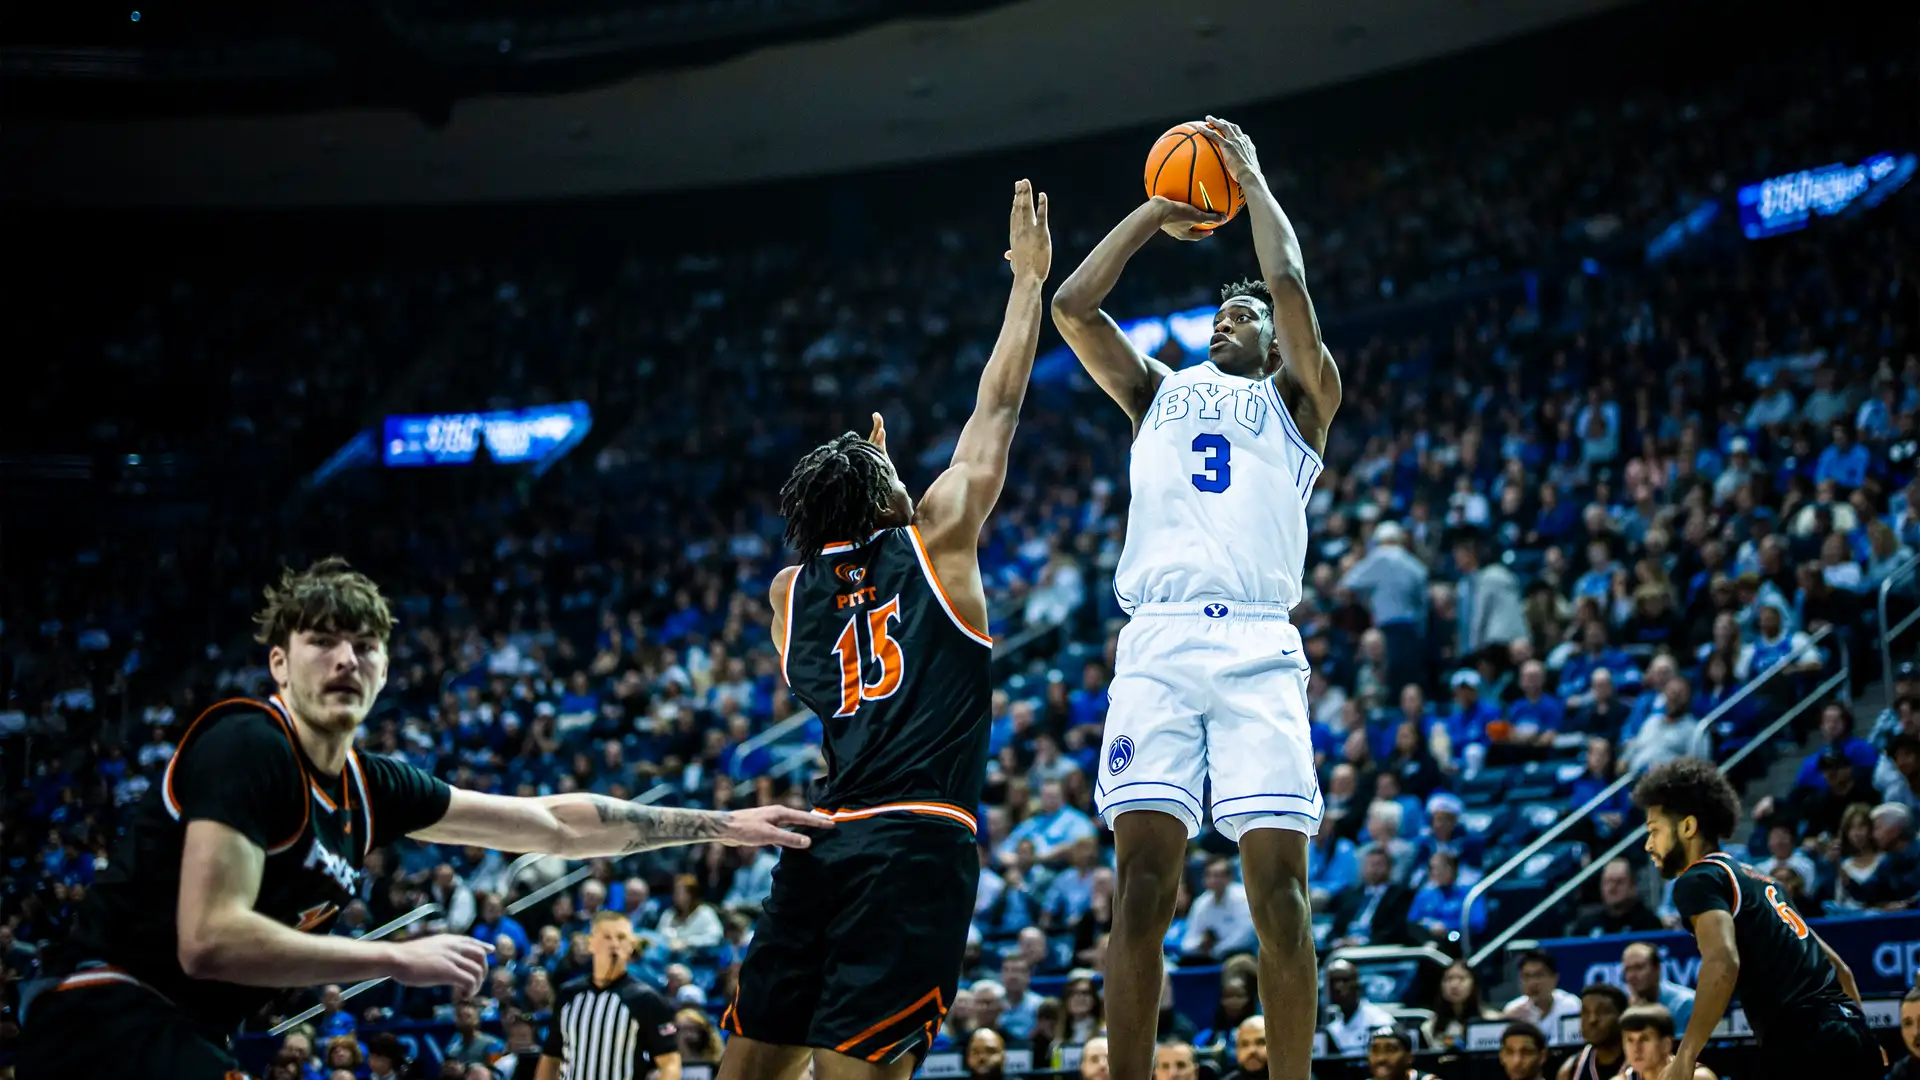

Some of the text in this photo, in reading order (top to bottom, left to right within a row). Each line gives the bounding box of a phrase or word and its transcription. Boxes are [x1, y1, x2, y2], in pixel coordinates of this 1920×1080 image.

[1154, 382, 1267, 436] BYU
[1191, 432, 1231, 494] 3
[836, 586, 877, 609] PITT
[1207, 604, 1225, 617] Y
[830, 593, 904, 719] 15
[1764, 885, 1810, 940] 6
